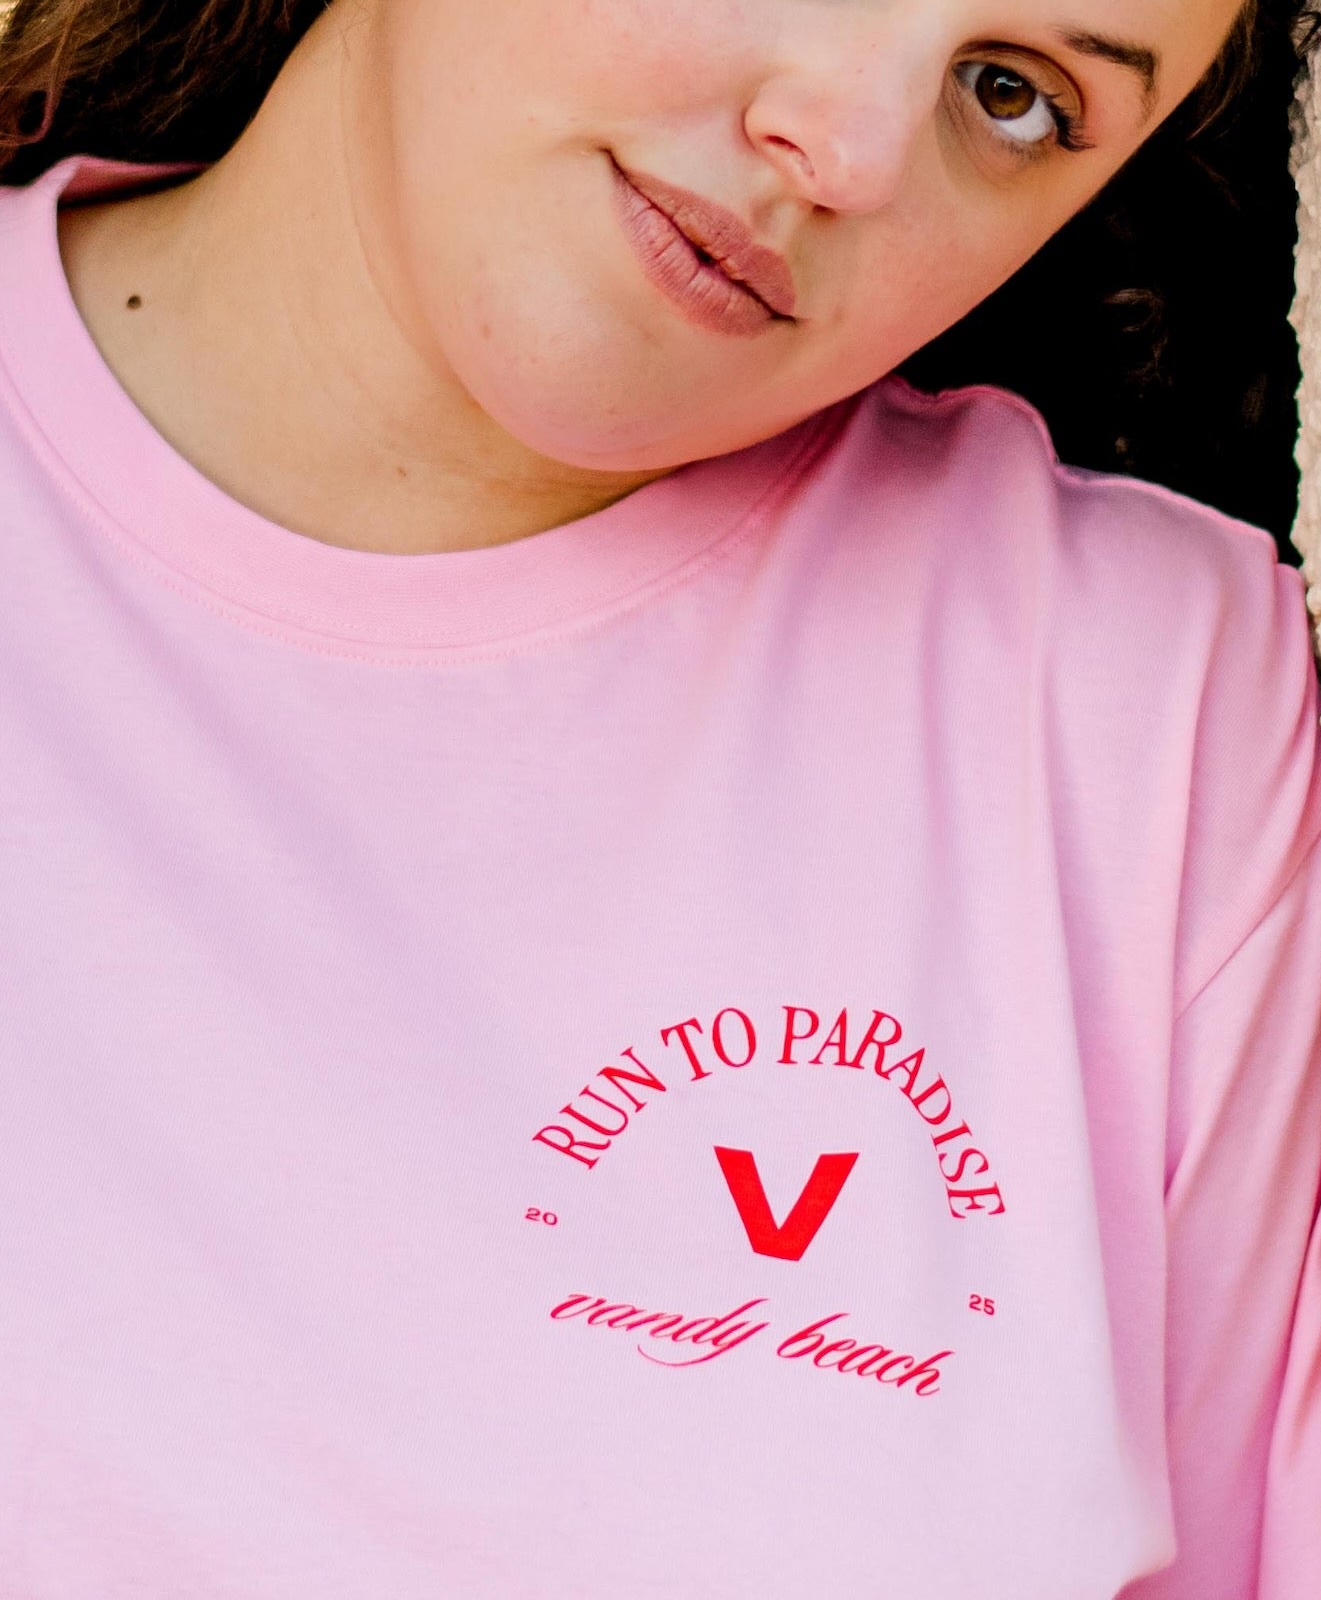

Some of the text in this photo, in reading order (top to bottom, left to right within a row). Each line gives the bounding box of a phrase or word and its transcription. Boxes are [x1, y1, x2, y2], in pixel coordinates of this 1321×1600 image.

[530, 1005, 1007, 1221] RUN TO PARADISE
[524, 1206, 559, 1228] 20
[713, 1145, 860, 1263] V
[549, 1293, 955, 1397] vandy beach
[968, 1293, 996, 1316] 25
